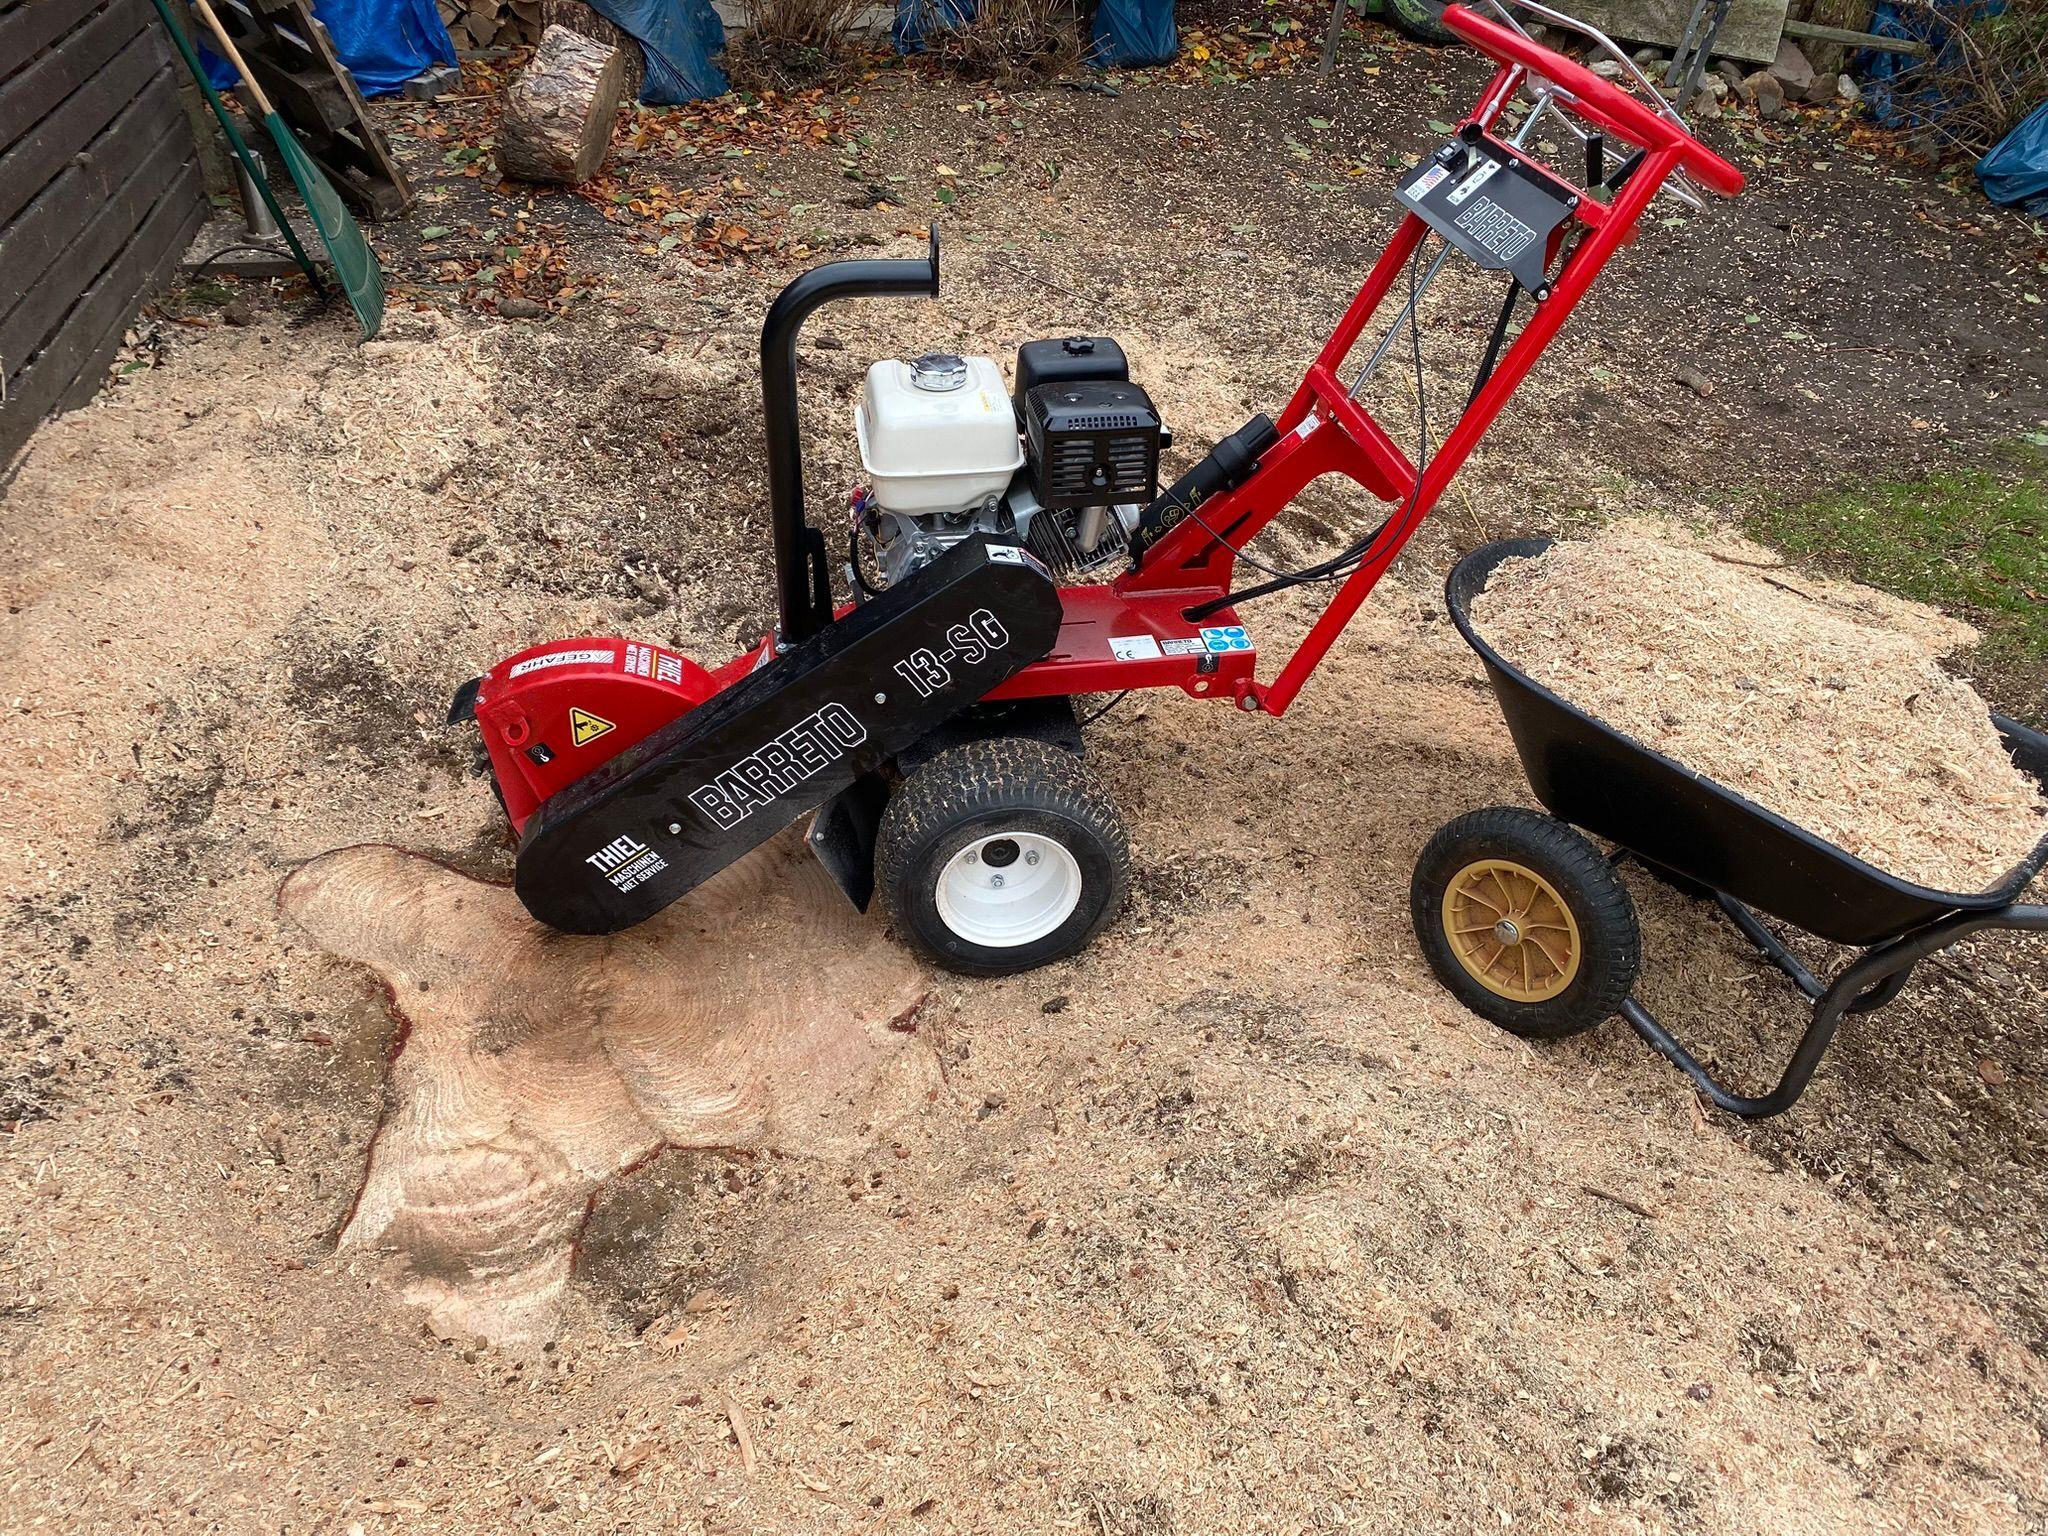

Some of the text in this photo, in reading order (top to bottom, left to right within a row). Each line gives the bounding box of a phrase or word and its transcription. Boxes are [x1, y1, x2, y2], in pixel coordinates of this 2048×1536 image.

[1453, 195, 1538, 262] BARRETO
[520, 652, 592, 671] GEFAHR
[656, 653, 683, 686] THIEL
[893, 608, 1009, 698] 13-SG
[687, 702, 867, 831] BARRETO
[585, 834, 647, 873] THIEL
[608, 850, 661, 887] MASCHINEN
[618, 858, 669, 894] MIET SERVICE
